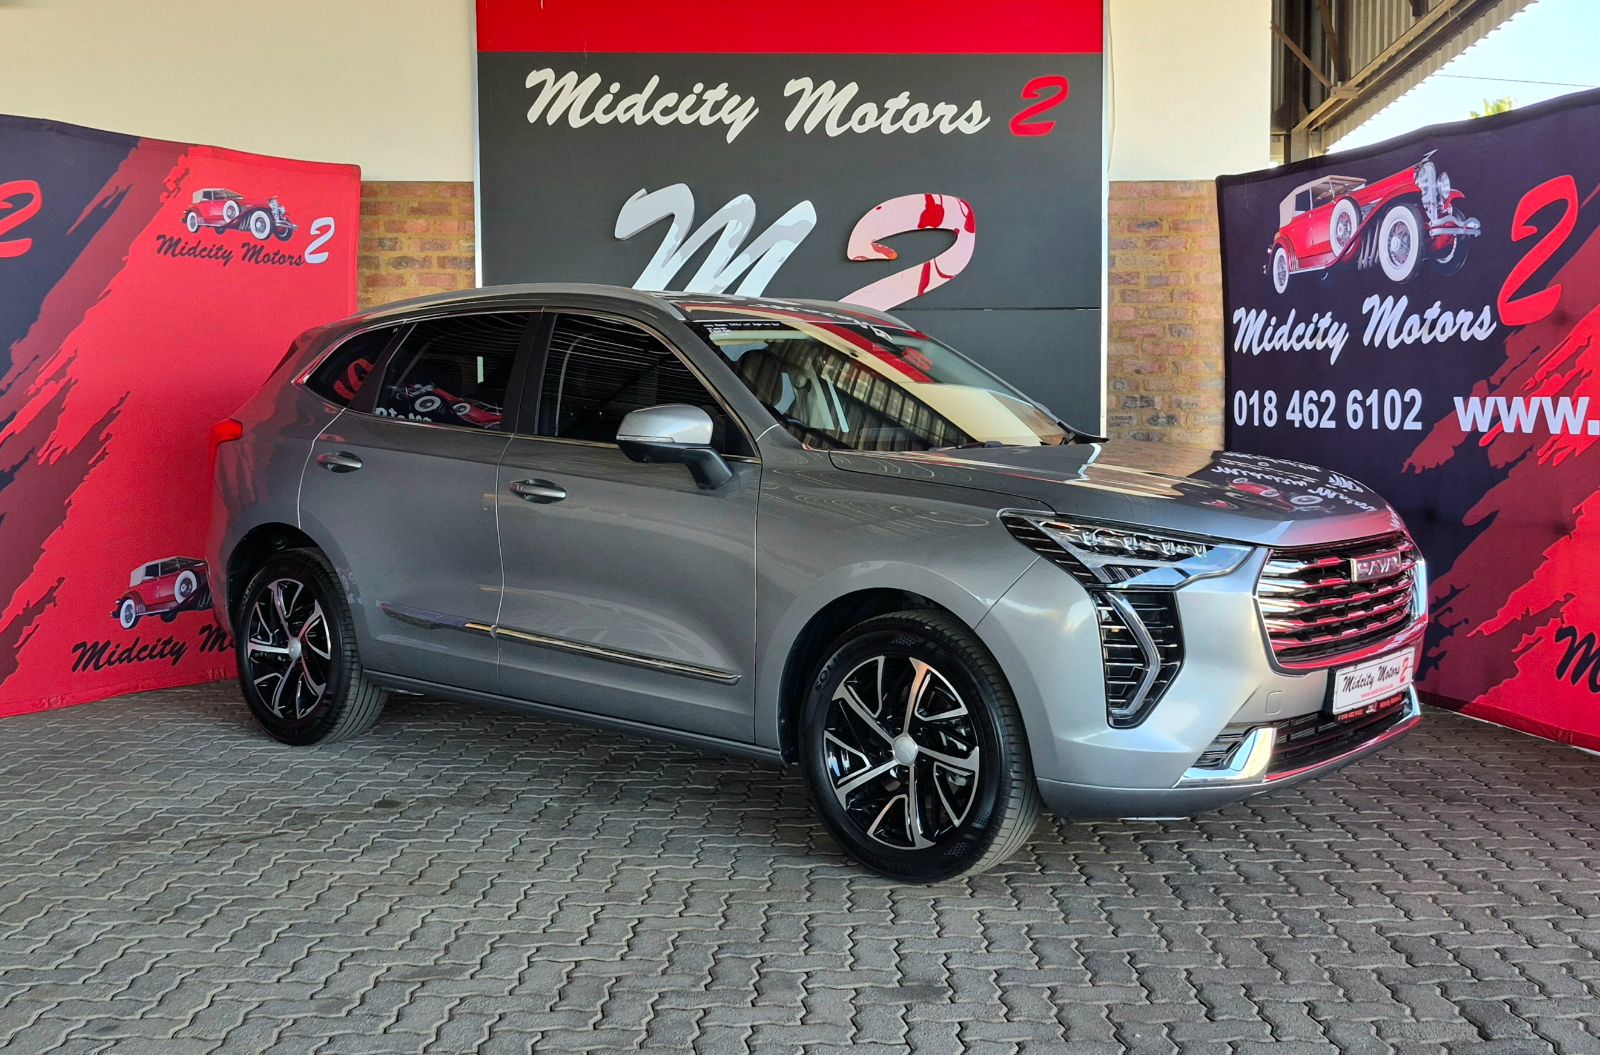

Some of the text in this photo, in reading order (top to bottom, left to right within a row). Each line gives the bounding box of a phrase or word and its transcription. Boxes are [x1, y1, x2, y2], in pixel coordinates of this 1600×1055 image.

[525, 67, 1069, 144] Midcity Motors 2
[156, 217, 335, 267] Midcity Motors 2
[1233, 175, 1579, 365] Midcity Motors 2
[1233, 389, 1278, 427] 018
[1285, 390, 1336, 429] 462
[1346, 389, 1422, 430] 6102
[72, 636, 188, 672] Midcity
[1342, 674, 1374, 692] Midcity
[1377, 665, 1400, 681] Motors
